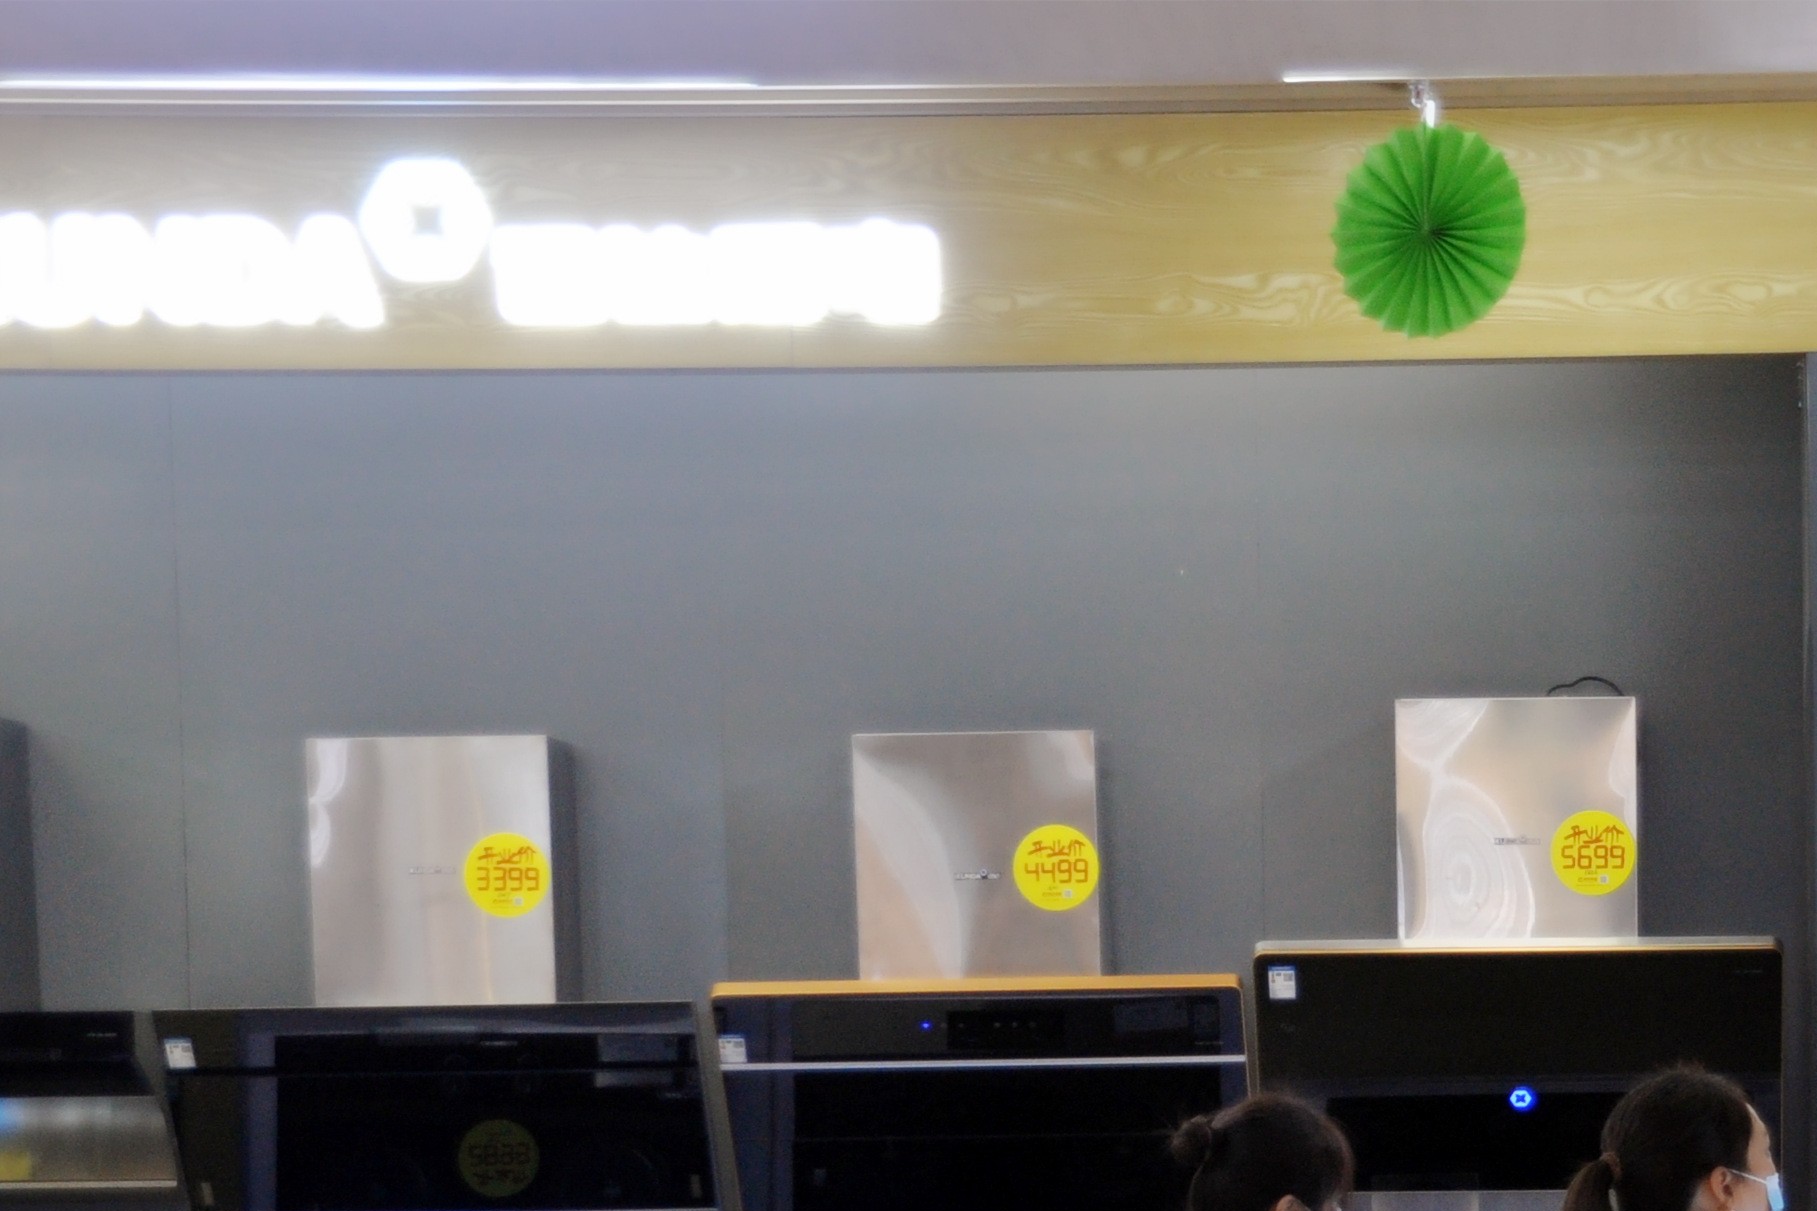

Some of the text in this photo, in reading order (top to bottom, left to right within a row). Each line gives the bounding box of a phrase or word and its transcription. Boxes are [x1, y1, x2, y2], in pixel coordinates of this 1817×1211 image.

[1561, 845, 1625, 869] 5699
[477, 867, 540, 892] 3399
[1024, 859, 1088, 883] 4499
